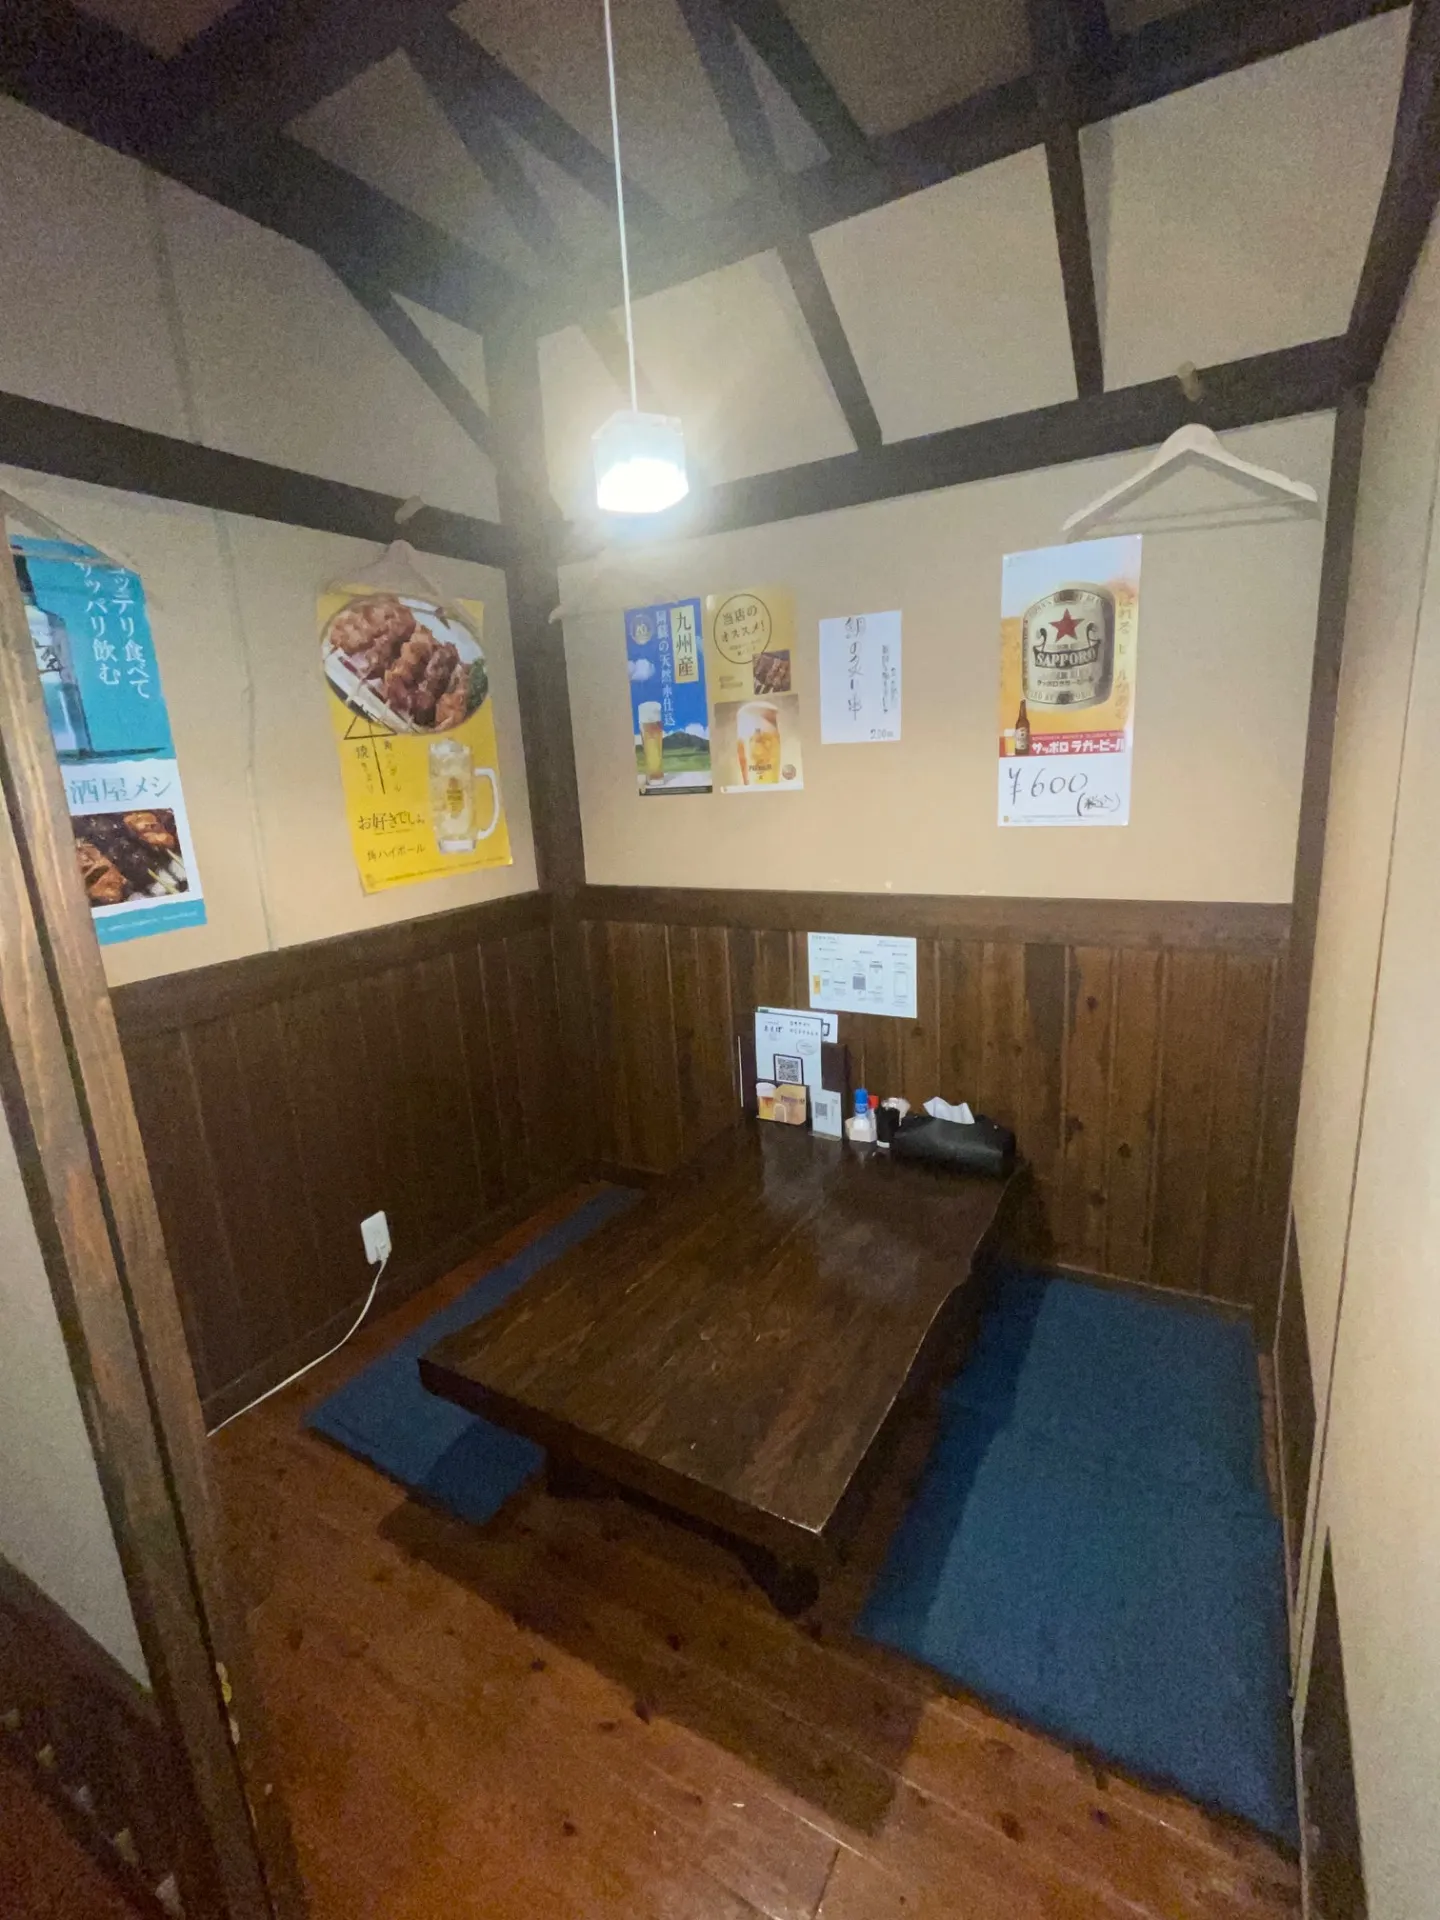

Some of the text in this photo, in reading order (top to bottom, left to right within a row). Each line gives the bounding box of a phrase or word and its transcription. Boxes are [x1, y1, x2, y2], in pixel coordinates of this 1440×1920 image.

[722, 605, 758, 626] 当店の
[675, 611, 695, 678] 九州産
[1036, 647, 1096, 667] SAPPORO
[1031, 737, 1125, 754] サッポロ ラガービール
[65, 775, 172, 805] 酒屋メシ
[1008, 767, 1089, 806] ¥600
